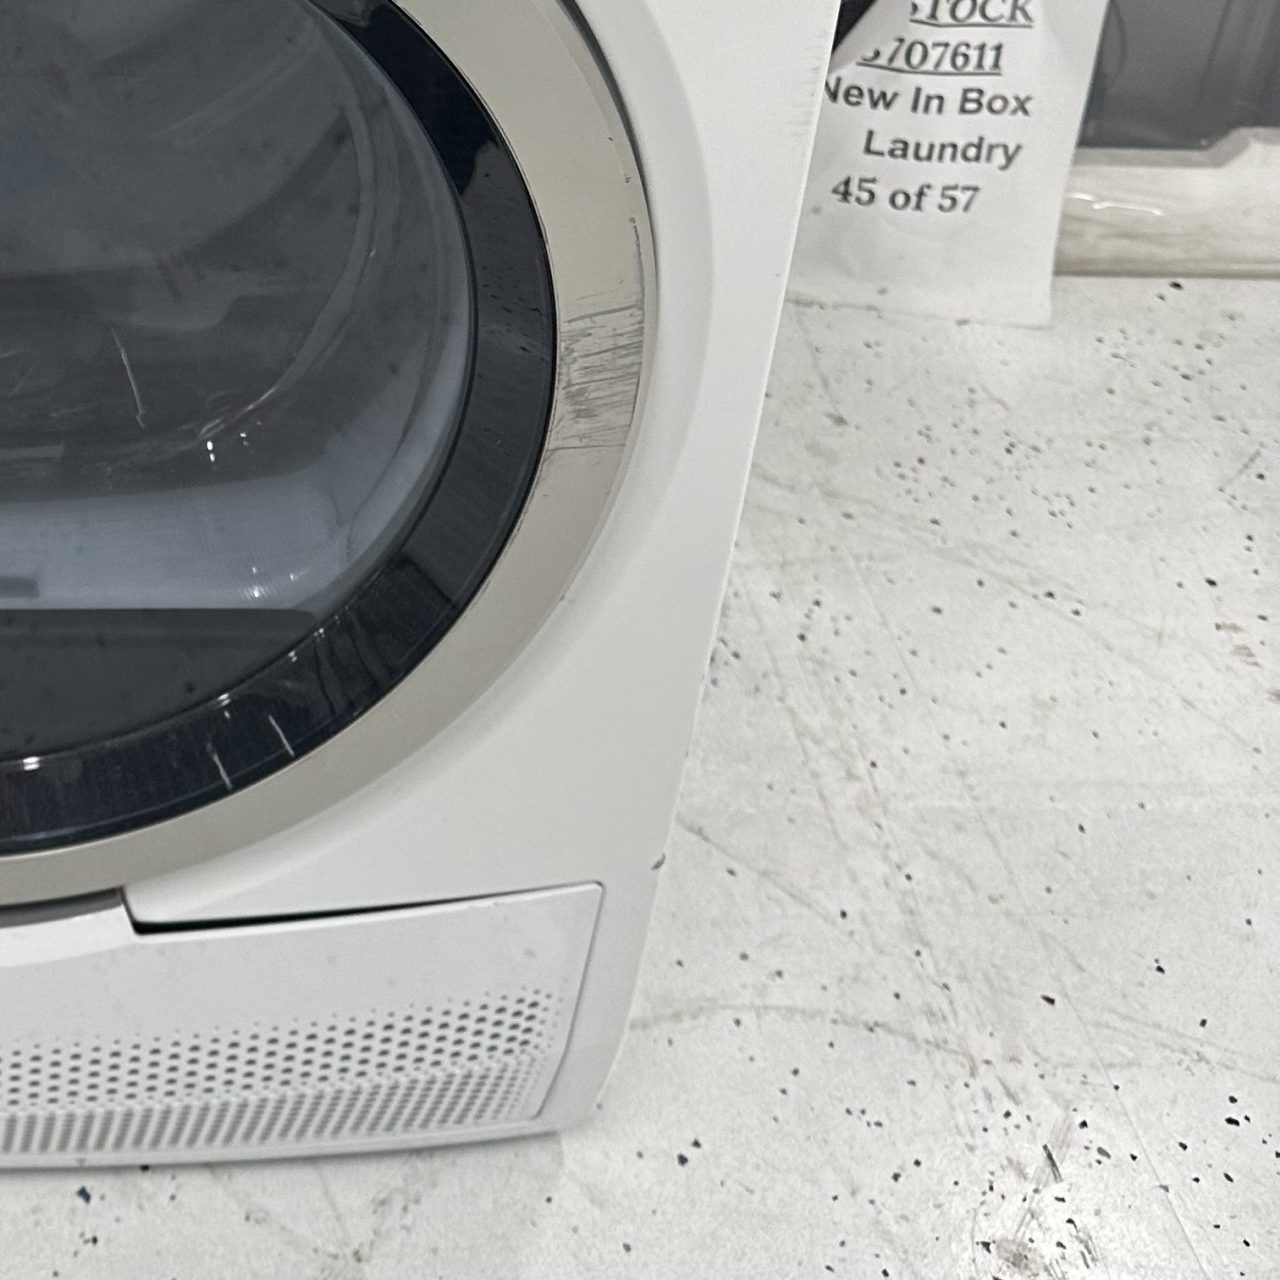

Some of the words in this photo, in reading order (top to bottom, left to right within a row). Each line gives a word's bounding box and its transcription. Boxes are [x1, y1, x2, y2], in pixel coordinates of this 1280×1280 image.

[824, 76, 900, 111] New
[910, 86, 946, 115] In
[959, 87, 1034, 117] Box
[863, 129, 1023, 171] Laundry
[831, 175, 878, 207] 45
[888, 183, 933, 212] of
[937, 183, 981, 213] 57
